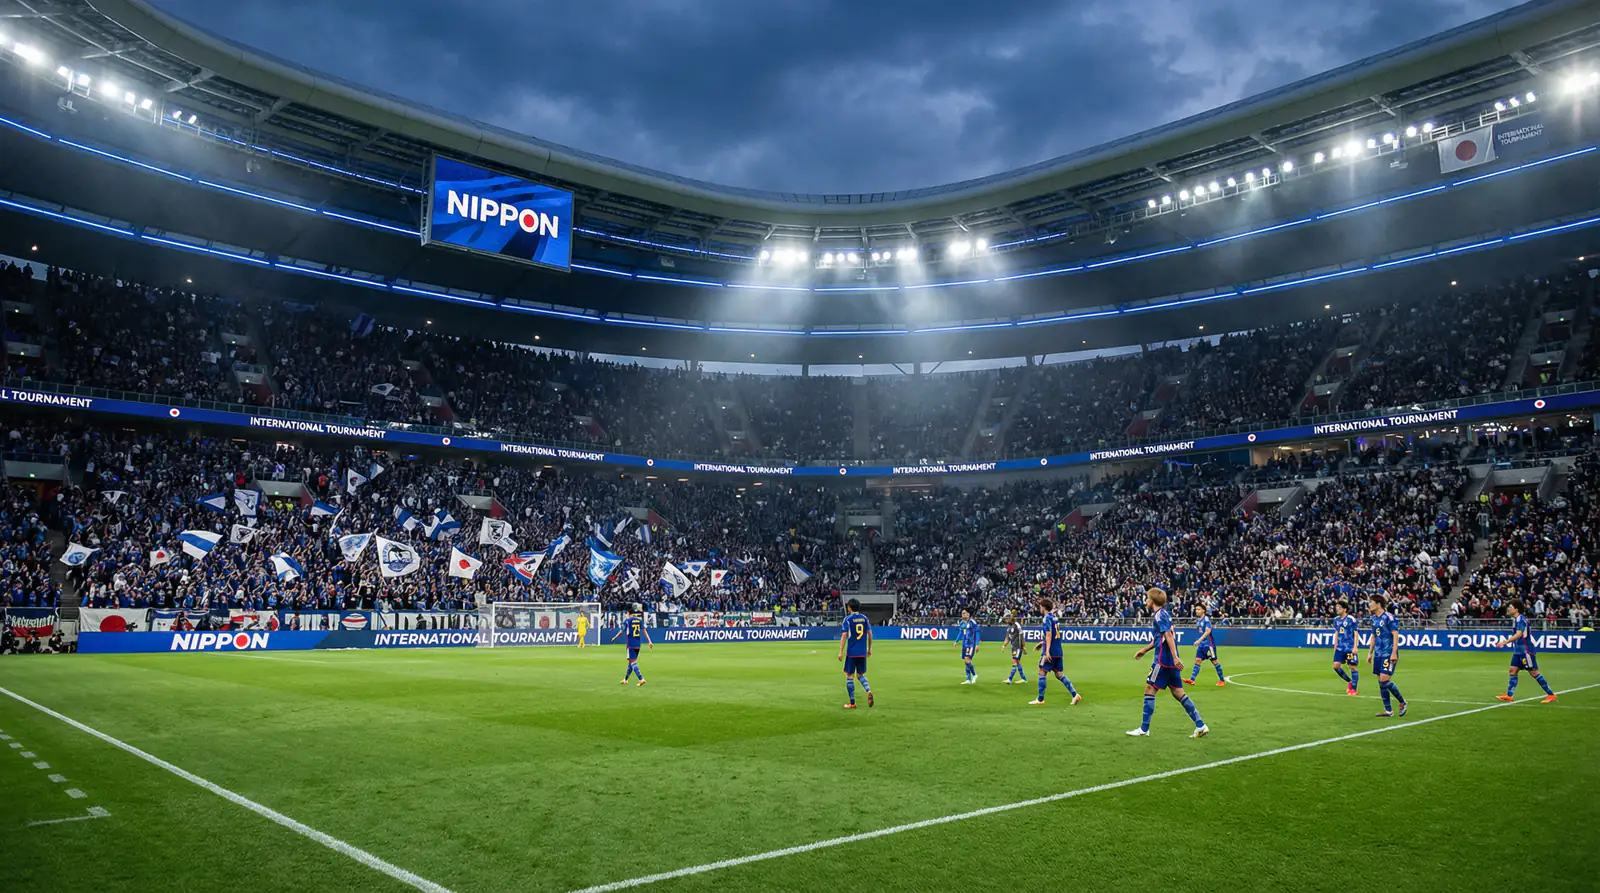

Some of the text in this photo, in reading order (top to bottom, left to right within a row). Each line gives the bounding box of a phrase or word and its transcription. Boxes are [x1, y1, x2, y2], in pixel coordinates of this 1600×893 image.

[447, 189, 559, 239] NIPPON
[12, 390, 92, 408] TOURNAMENT
[250, 416, 386, 439] INTERNATIONAL TOURNAMENT
[1314, 410, 1458, 434] INTERNATIONAL TOURNAMENT
[500, 443, 604, 462] INTERNATIONAL TOURNAMENT
[1090, 441, 1195, 461] INTERNATIONAL TOURNAMENT
[694, 463, 793, 474] INTERNATIONAL TOURNAMENT
[893, 462, 996, 474] INTERNATIONAL TOURNAMENT
[374, 631, 579, 646] INTERNATIONAL TOURNAMENT
[665, 629, 809, 641] INTERNATIONAL TOURNAMENT
[855, 623, 864, 640] 9
[901, 627, 948, 640] NIPPON
[171, 632, 269, 650] NIPPON
[1447, 634, 1586, 649] TOURNMENT
